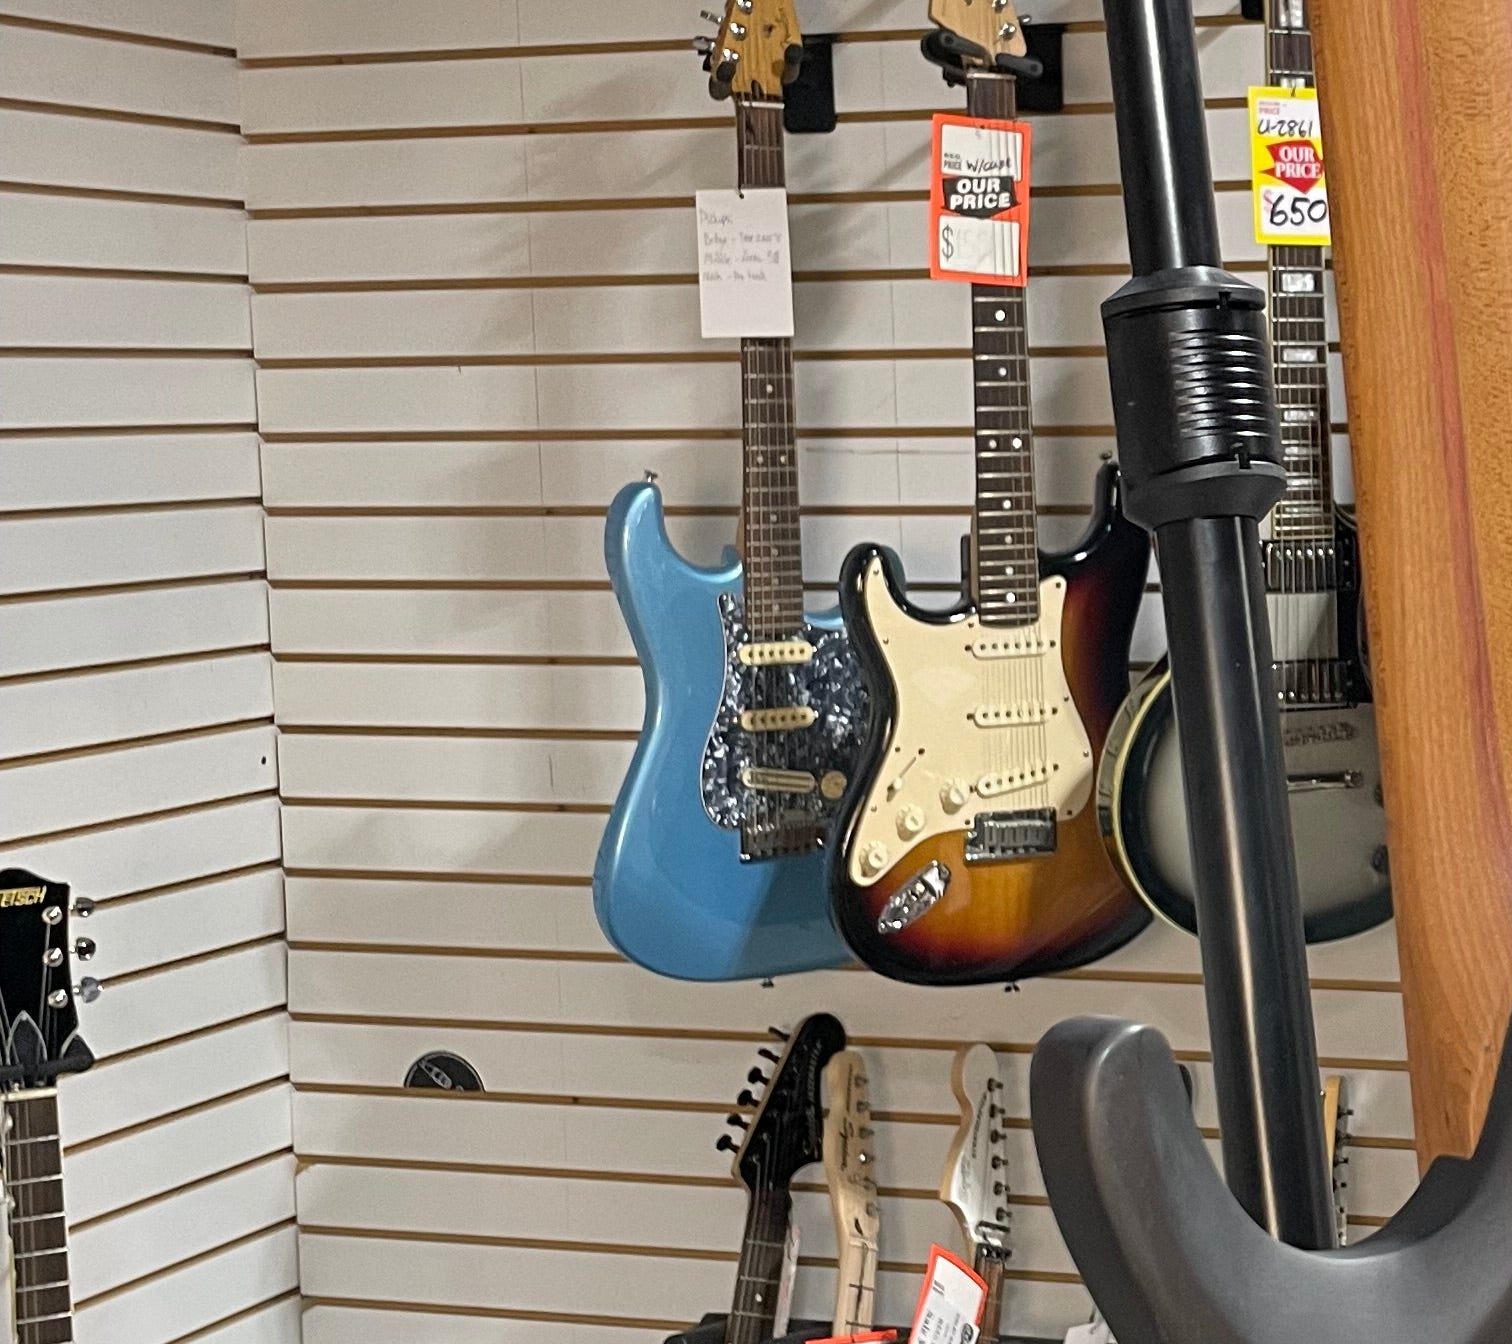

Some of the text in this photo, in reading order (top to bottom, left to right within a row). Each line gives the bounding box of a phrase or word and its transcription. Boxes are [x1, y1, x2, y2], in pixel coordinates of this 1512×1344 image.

[1279, 145, 1315, 163] OUR
[1275, 162, 1322, 180] PRICE
[955, 177, 1001, 195] OUR
[949, 192, 1012, 211] PRICE
[0, 884, 47, 908] ETSCH
